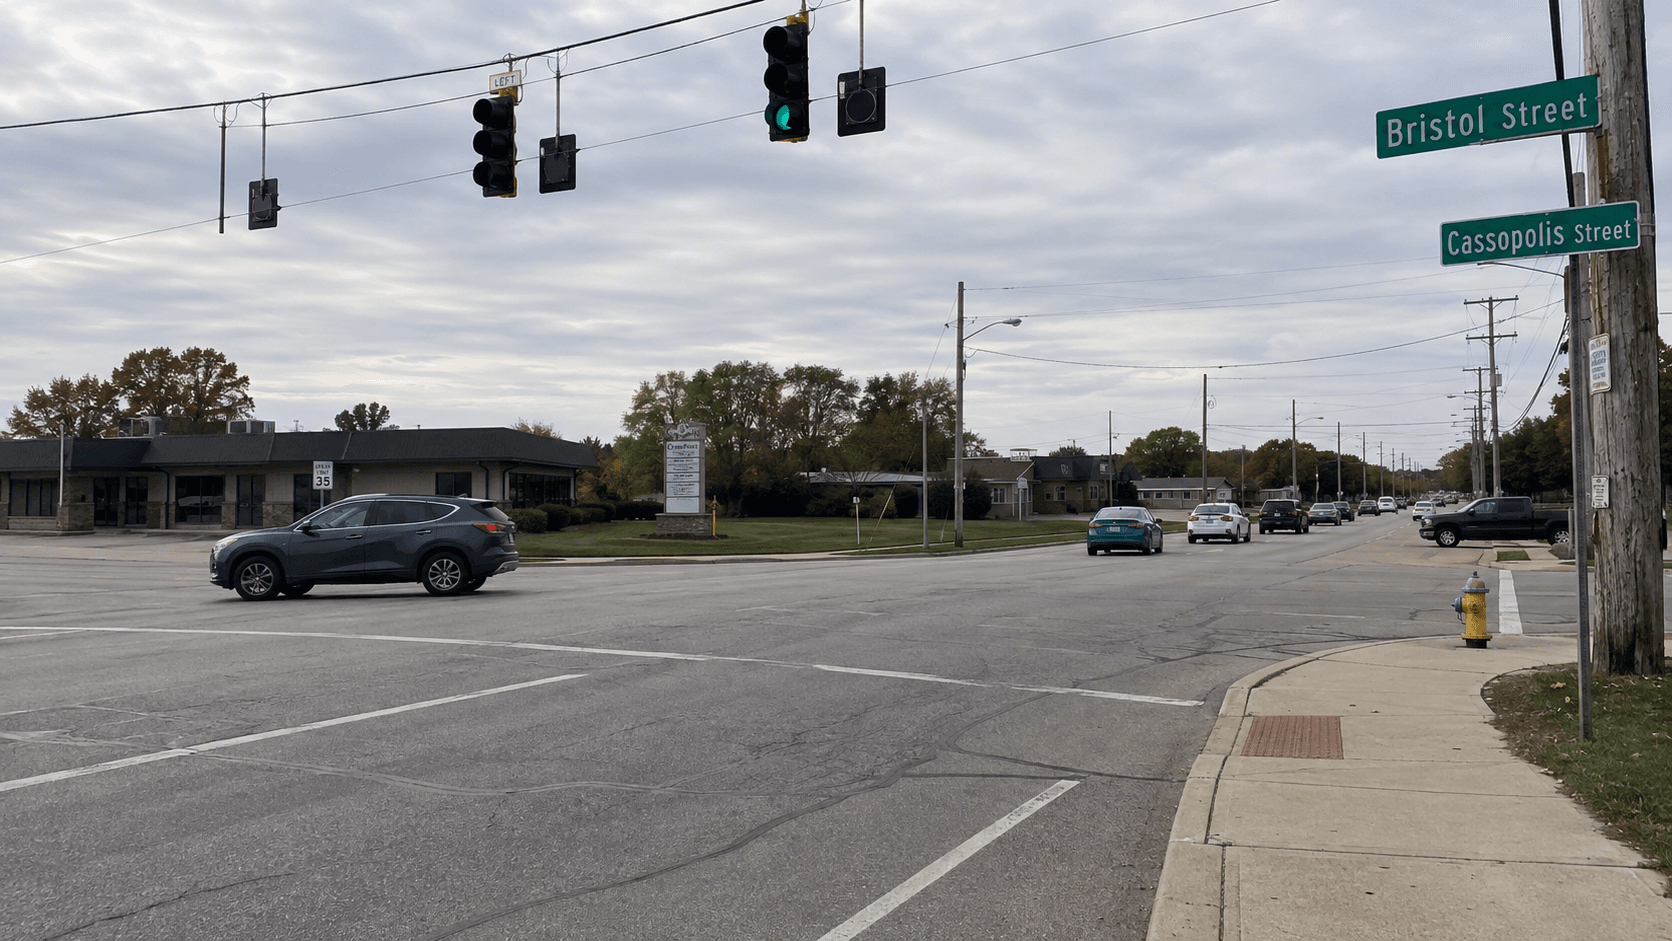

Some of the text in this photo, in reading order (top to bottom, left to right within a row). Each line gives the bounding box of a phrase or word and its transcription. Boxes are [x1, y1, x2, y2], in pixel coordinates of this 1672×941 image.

[1387, 92, 1588, 148] Bristol Street
[1447, 219, 1632, 256] Cassopolis Street
[316, 476, 330, 487] 35
